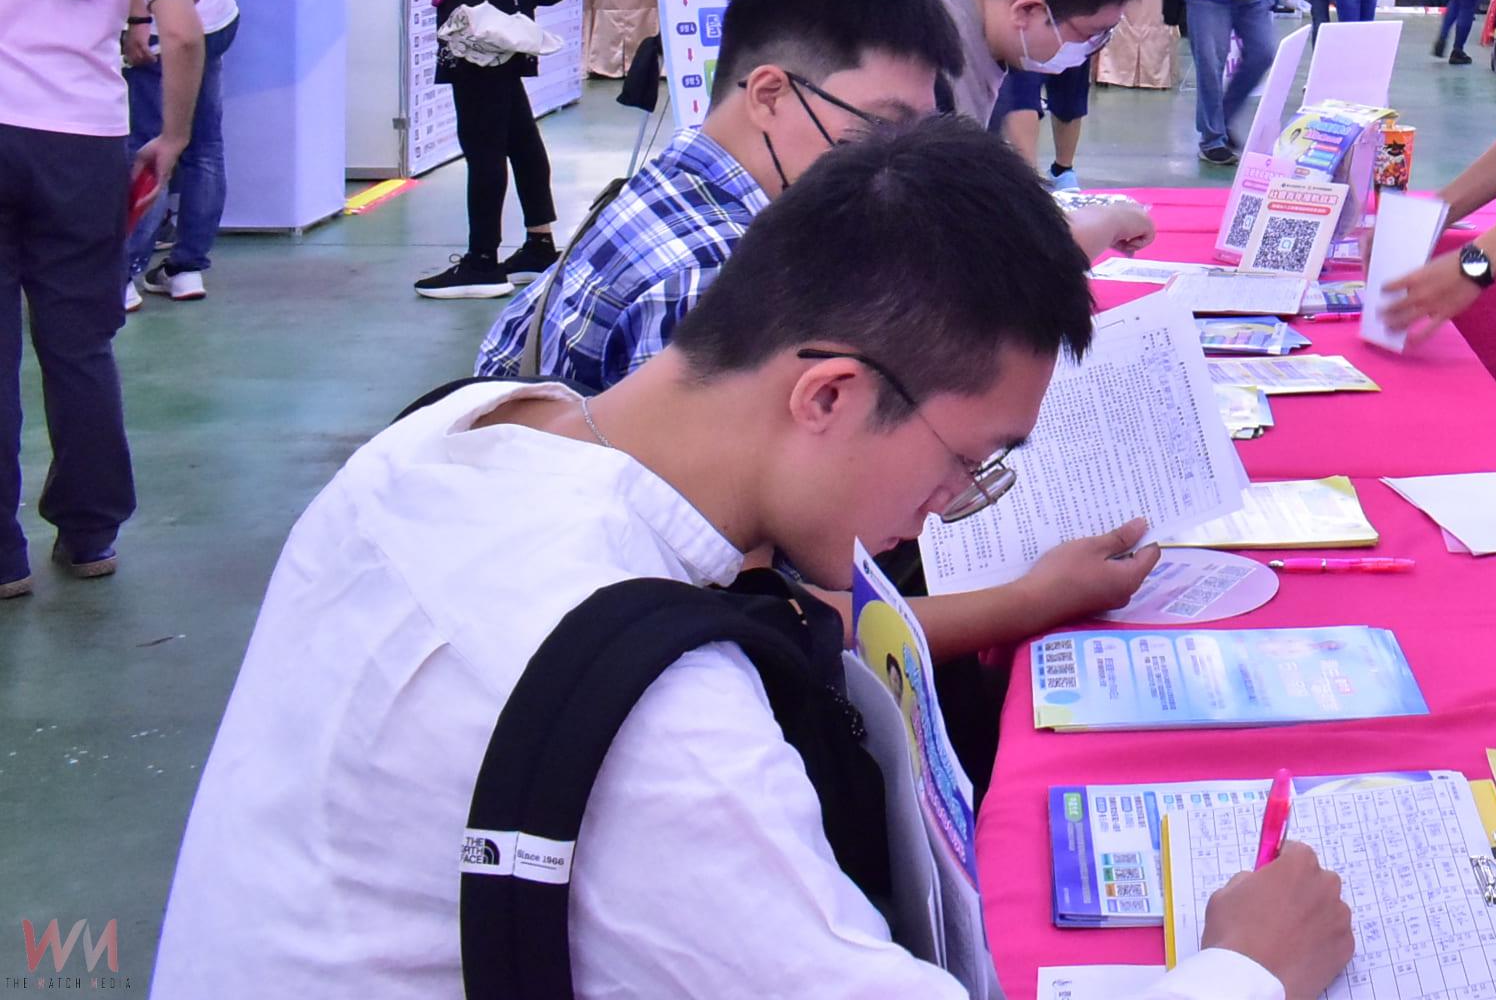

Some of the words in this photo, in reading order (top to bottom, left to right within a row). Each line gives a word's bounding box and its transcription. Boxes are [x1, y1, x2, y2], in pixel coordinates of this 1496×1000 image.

[465, 836, 484, 847] THE
[517, 849, 541, 861] Since
[542, 855, 565, 866] 1966
